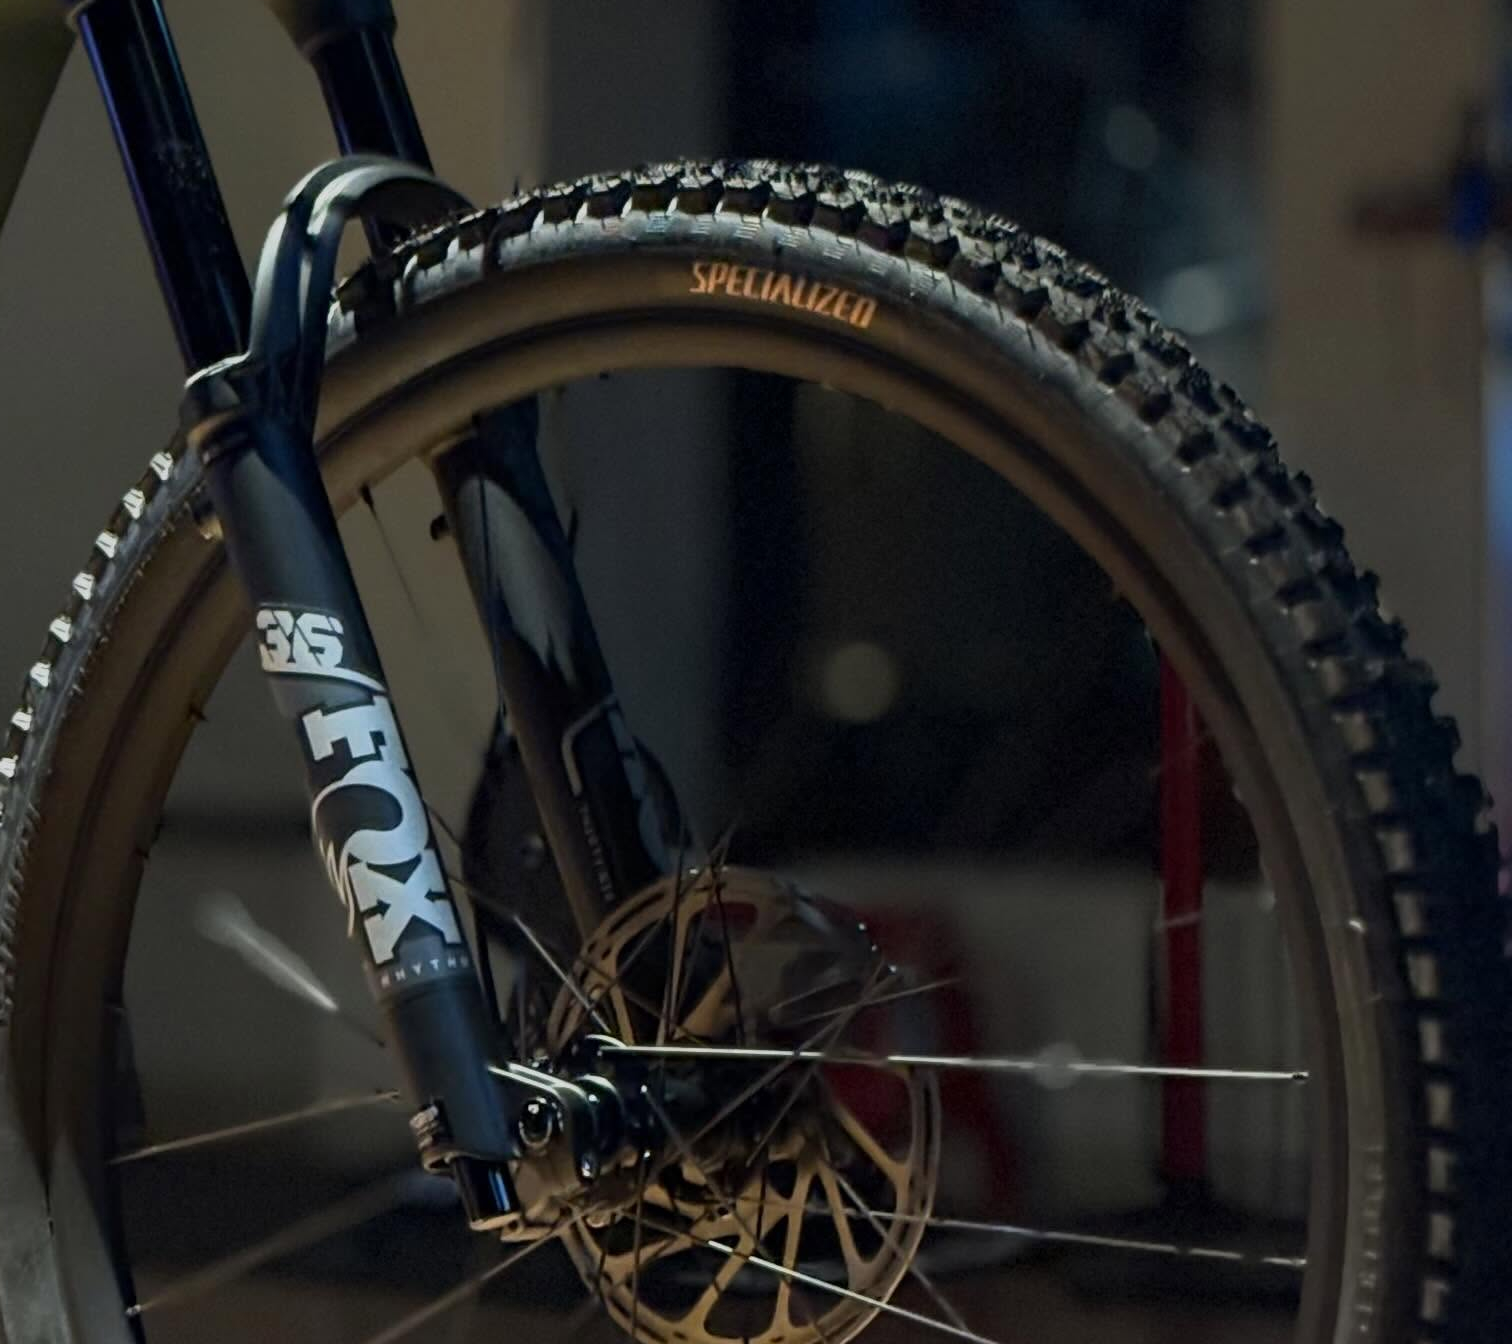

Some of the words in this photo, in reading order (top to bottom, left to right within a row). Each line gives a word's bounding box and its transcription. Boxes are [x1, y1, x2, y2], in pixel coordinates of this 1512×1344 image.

[688, 261, 879, 329] SPECIALIZED
[255, 608, 345, 671] 36
[300, 694, 464, 965] FOX
